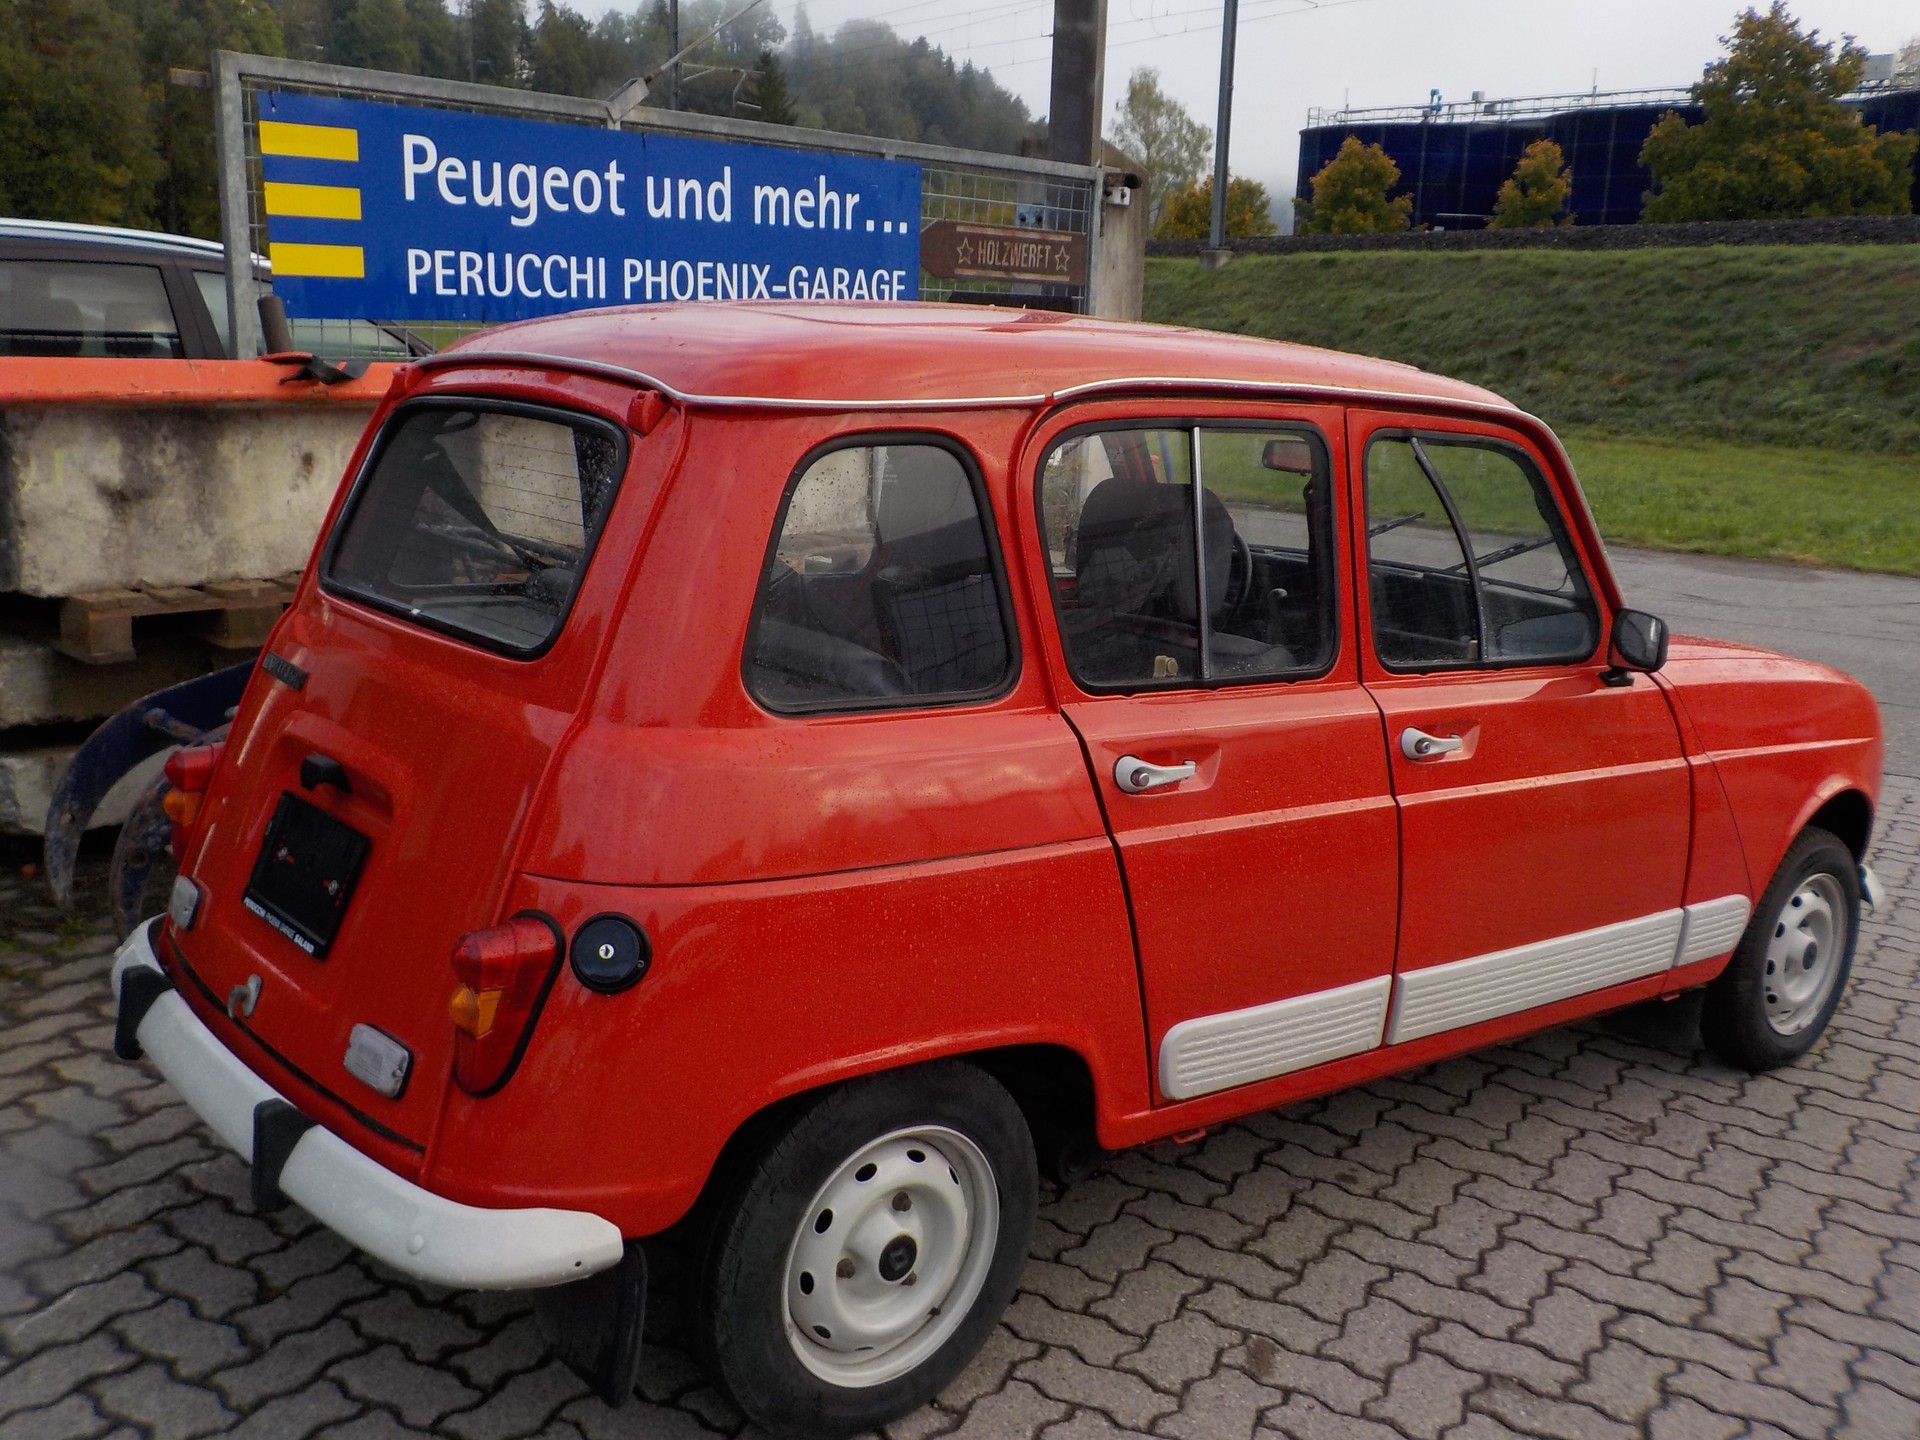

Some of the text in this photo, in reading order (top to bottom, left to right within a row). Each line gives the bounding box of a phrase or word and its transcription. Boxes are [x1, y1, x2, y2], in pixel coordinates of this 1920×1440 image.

[403, 134, 908, 234] Peugeot und mehr...
[407, 248, 906, 301] PERUCCHI PHOENIX-GARAGE
[977, 240, 1052, 269] HOLZWERFT
